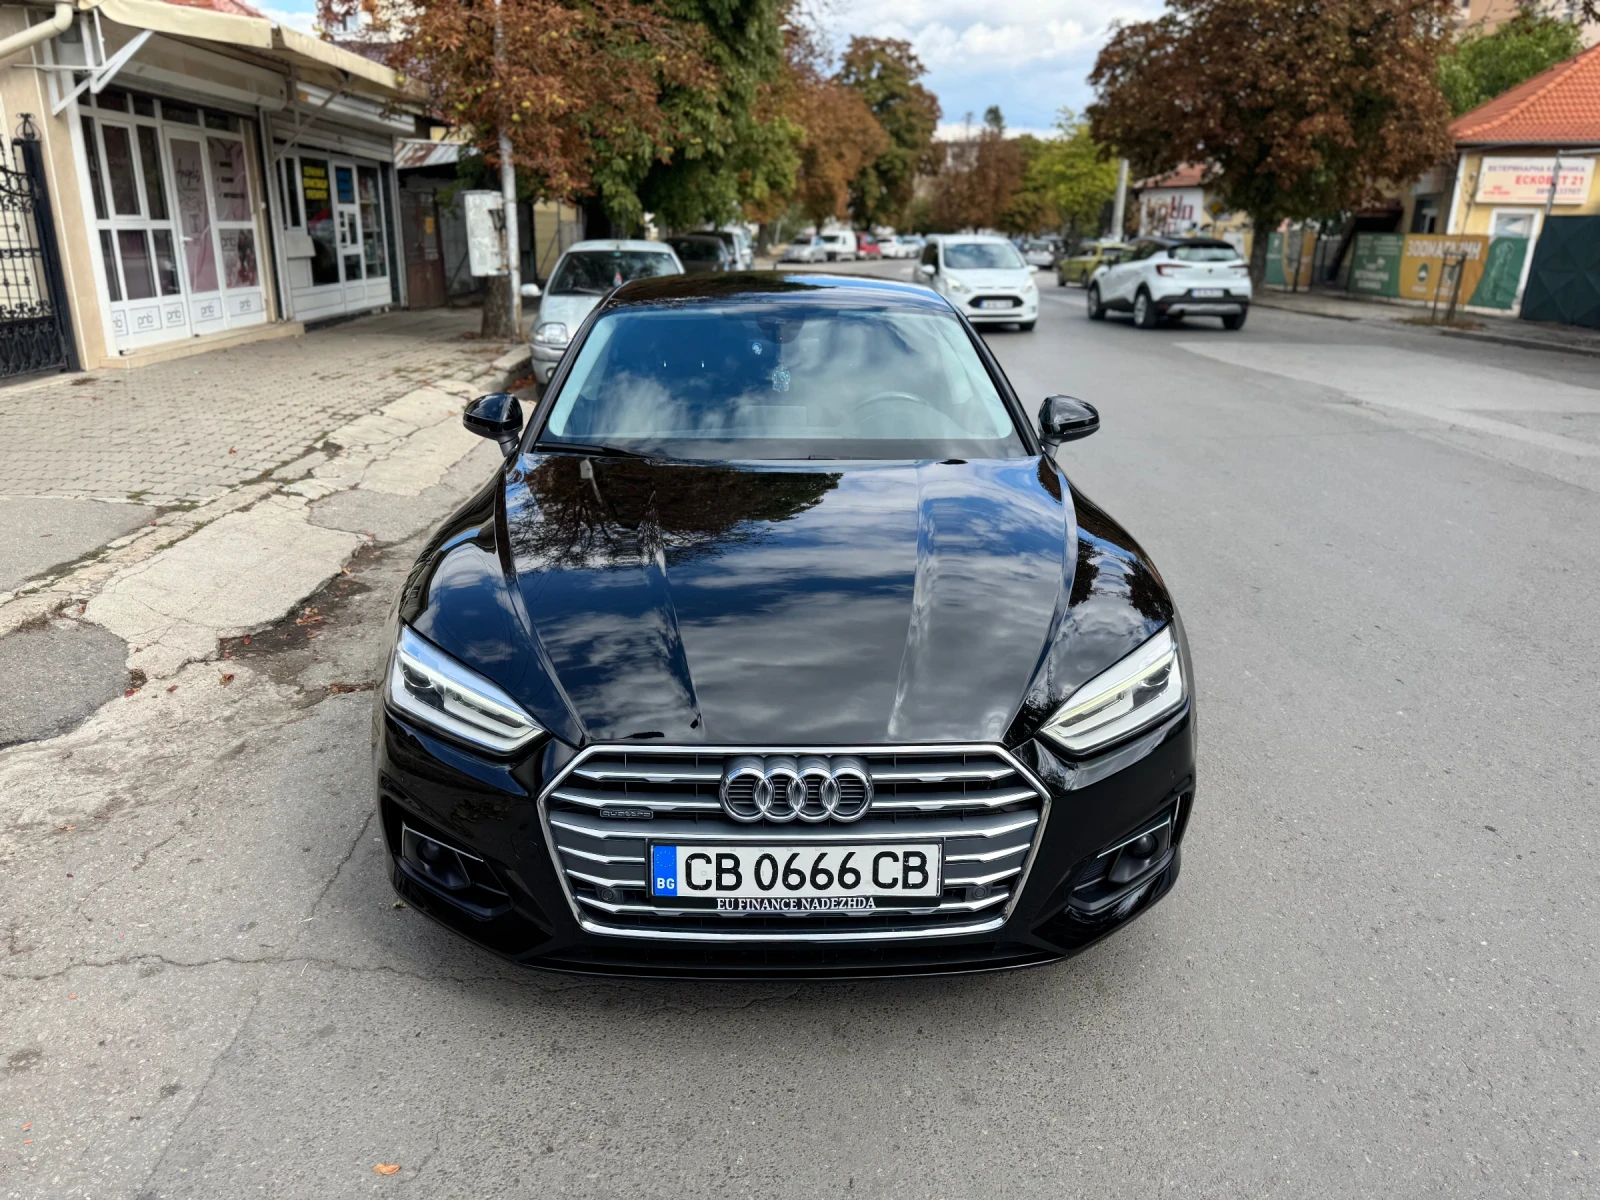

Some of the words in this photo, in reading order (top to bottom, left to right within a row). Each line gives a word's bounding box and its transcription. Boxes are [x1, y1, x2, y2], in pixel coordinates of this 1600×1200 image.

[1515, 175, 1568, 185] ЕСКОВТ
[1571, 175, 1584, 185] 21
[166, 309, 182, 320] pnb
[201, 305, 215, 317] pnb
[137, 313, 154, 326] pnb
[685, 852, 743, 891] CB
[754, 851, 862, 891] 0666
[872, 850, 929, 889] CB
[656, 877, 675, 889] BG
[716, 898, 734, 910] EU
[738, 898, 798, 910] FINANCE
[801, 897, 877, 910] NADEZHDA
